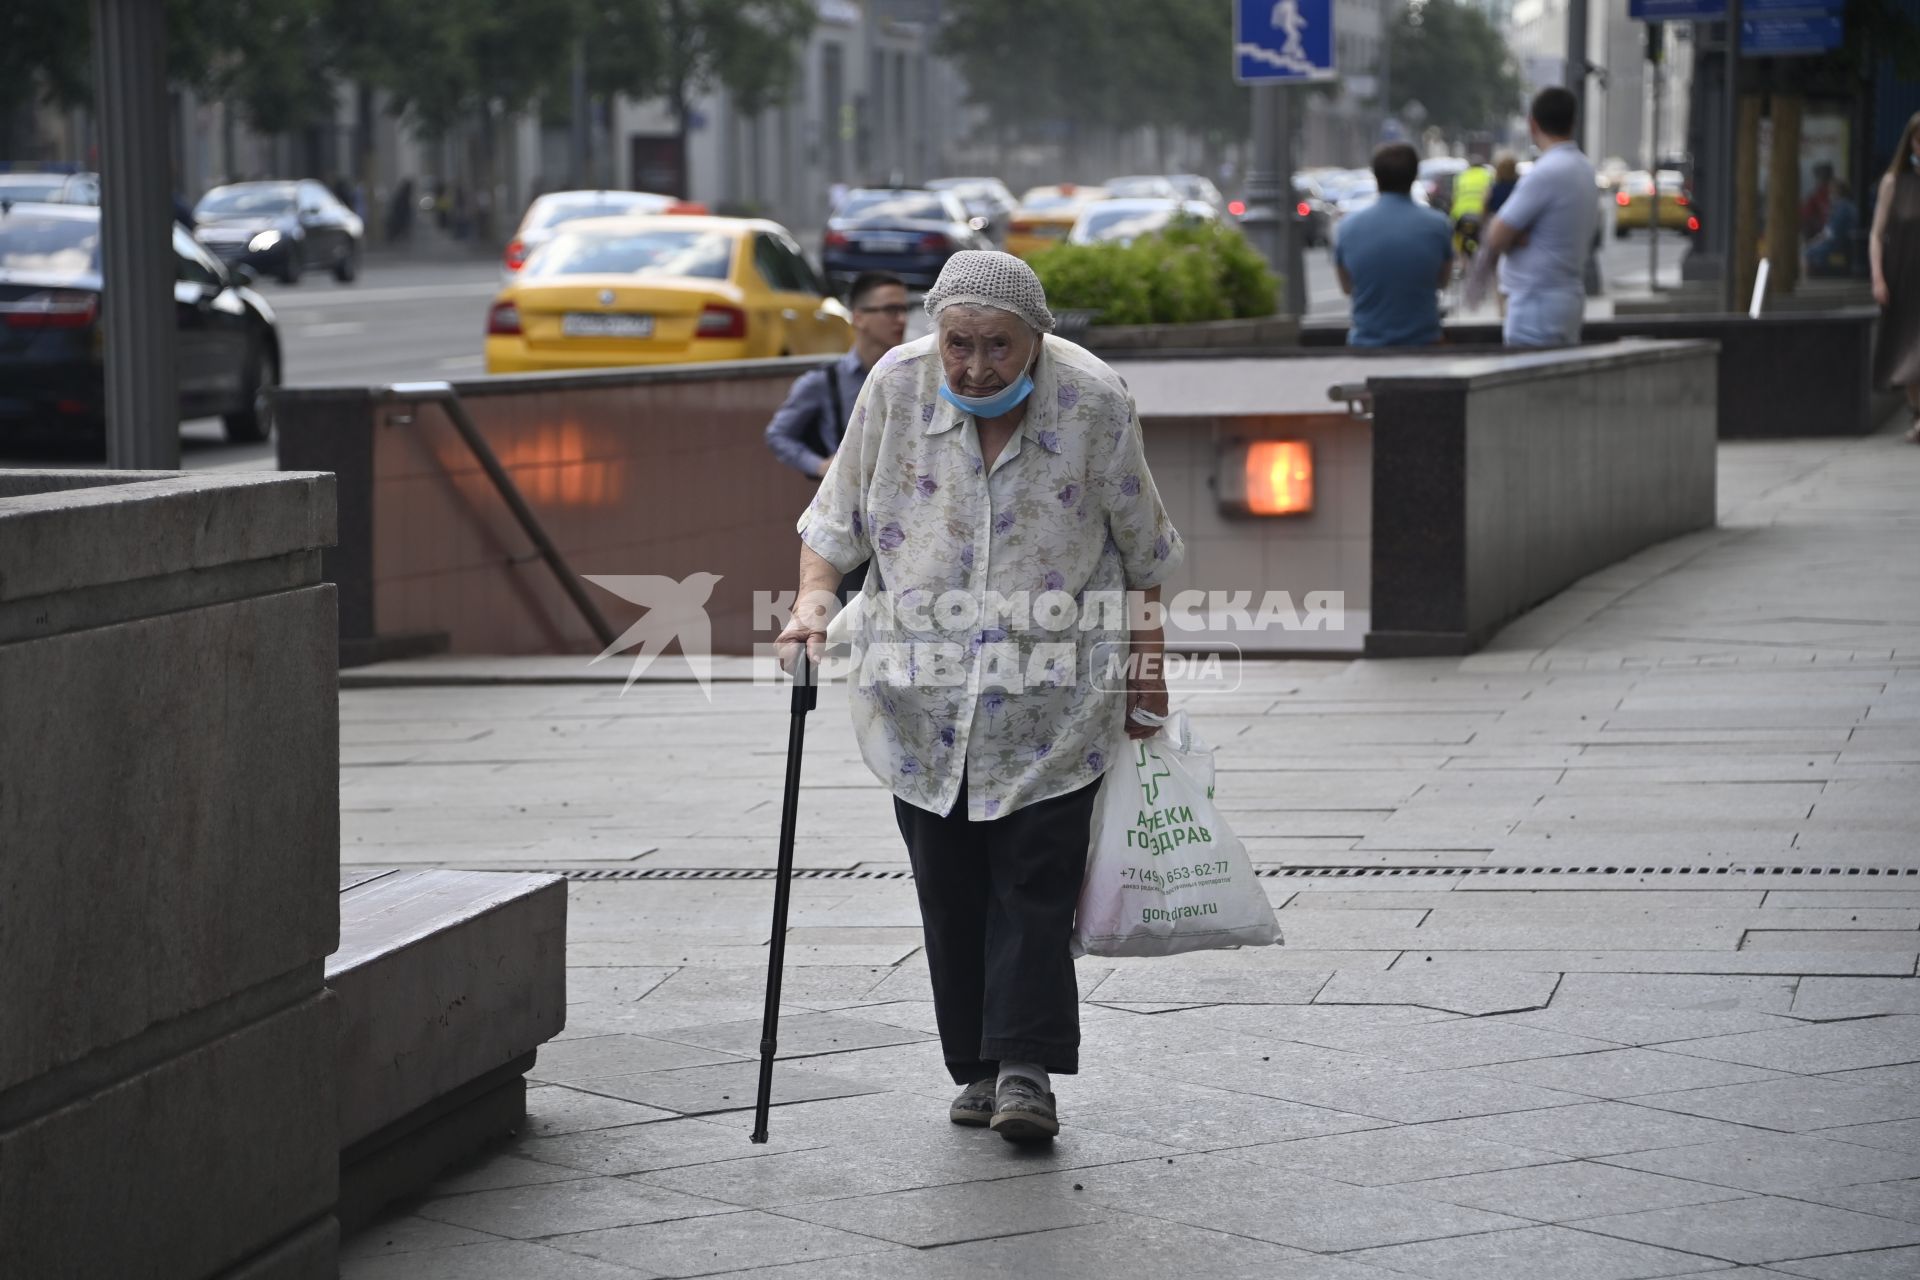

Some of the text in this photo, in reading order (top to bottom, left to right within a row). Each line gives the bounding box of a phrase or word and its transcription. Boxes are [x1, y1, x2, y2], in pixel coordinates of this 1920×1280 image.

[1127, 826, 1212, 856] ГОЗДРАВ
[1120, 867, 1136, 880] +7
[1139, 868, 1165, 889] (49)
[1166, 861, 1229, 883] 653-62-77
